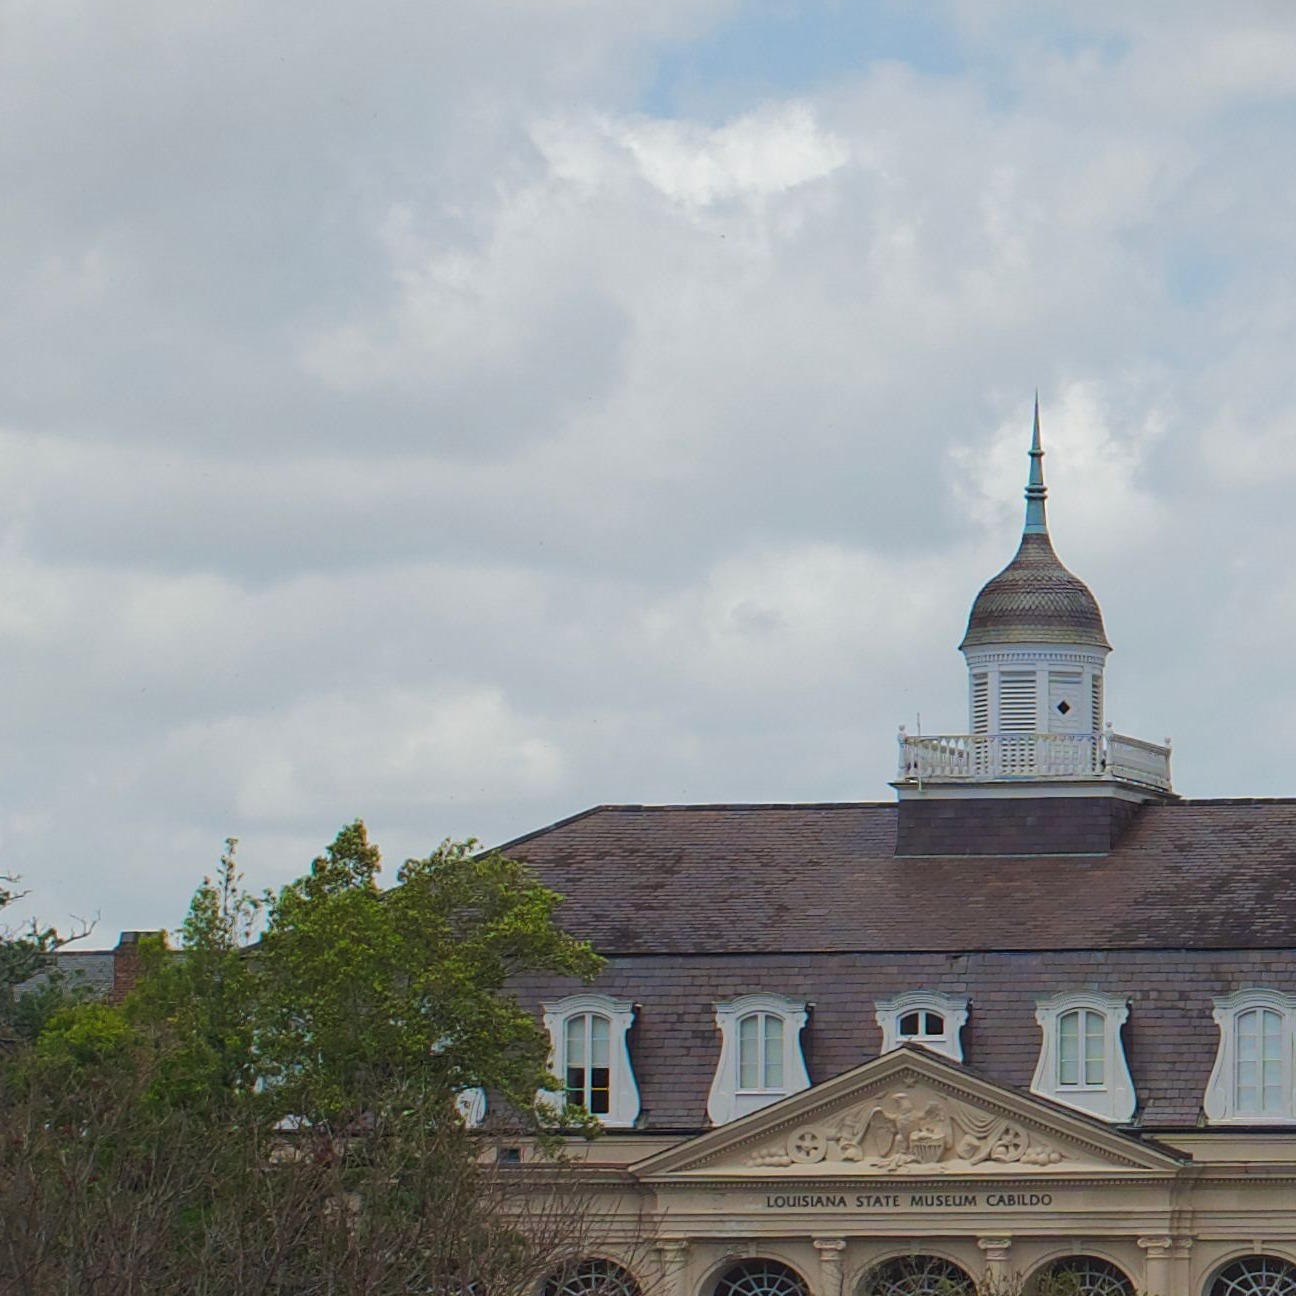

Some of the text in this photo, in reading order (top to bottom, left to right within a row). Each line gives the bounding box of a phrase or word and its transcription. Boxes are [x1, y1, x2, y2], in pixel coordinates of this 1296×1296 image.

[766, 1194, 1053, 1208] LOUISIANA STATE MUSEUM CABILDO
